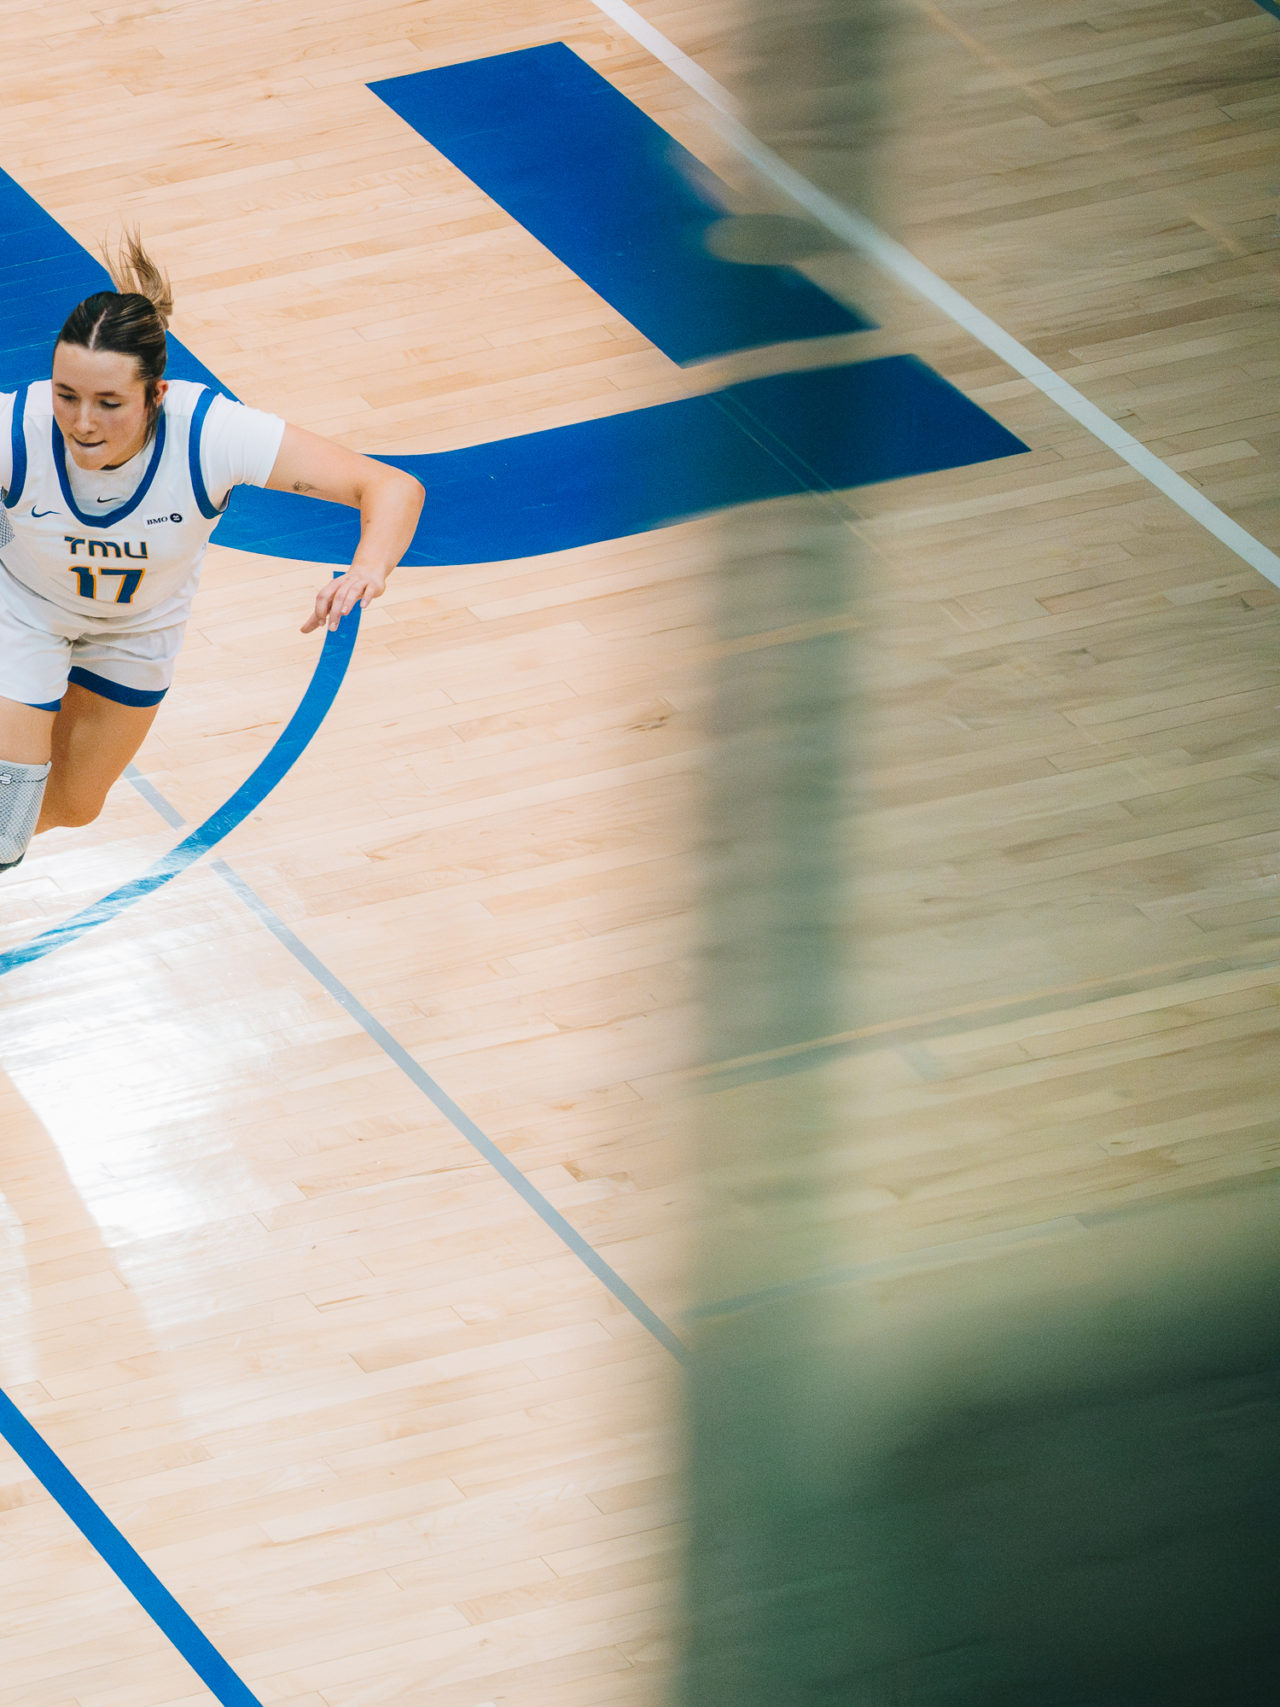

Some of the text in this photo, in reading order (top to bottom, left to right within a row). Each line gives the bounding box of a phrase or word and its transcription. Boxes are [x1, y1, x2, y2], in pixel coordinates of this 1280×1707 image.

[146, 516, 168, 525] BMO
[63, 535, 149, 560] TMU
[68, 565, 146, 605] 17
